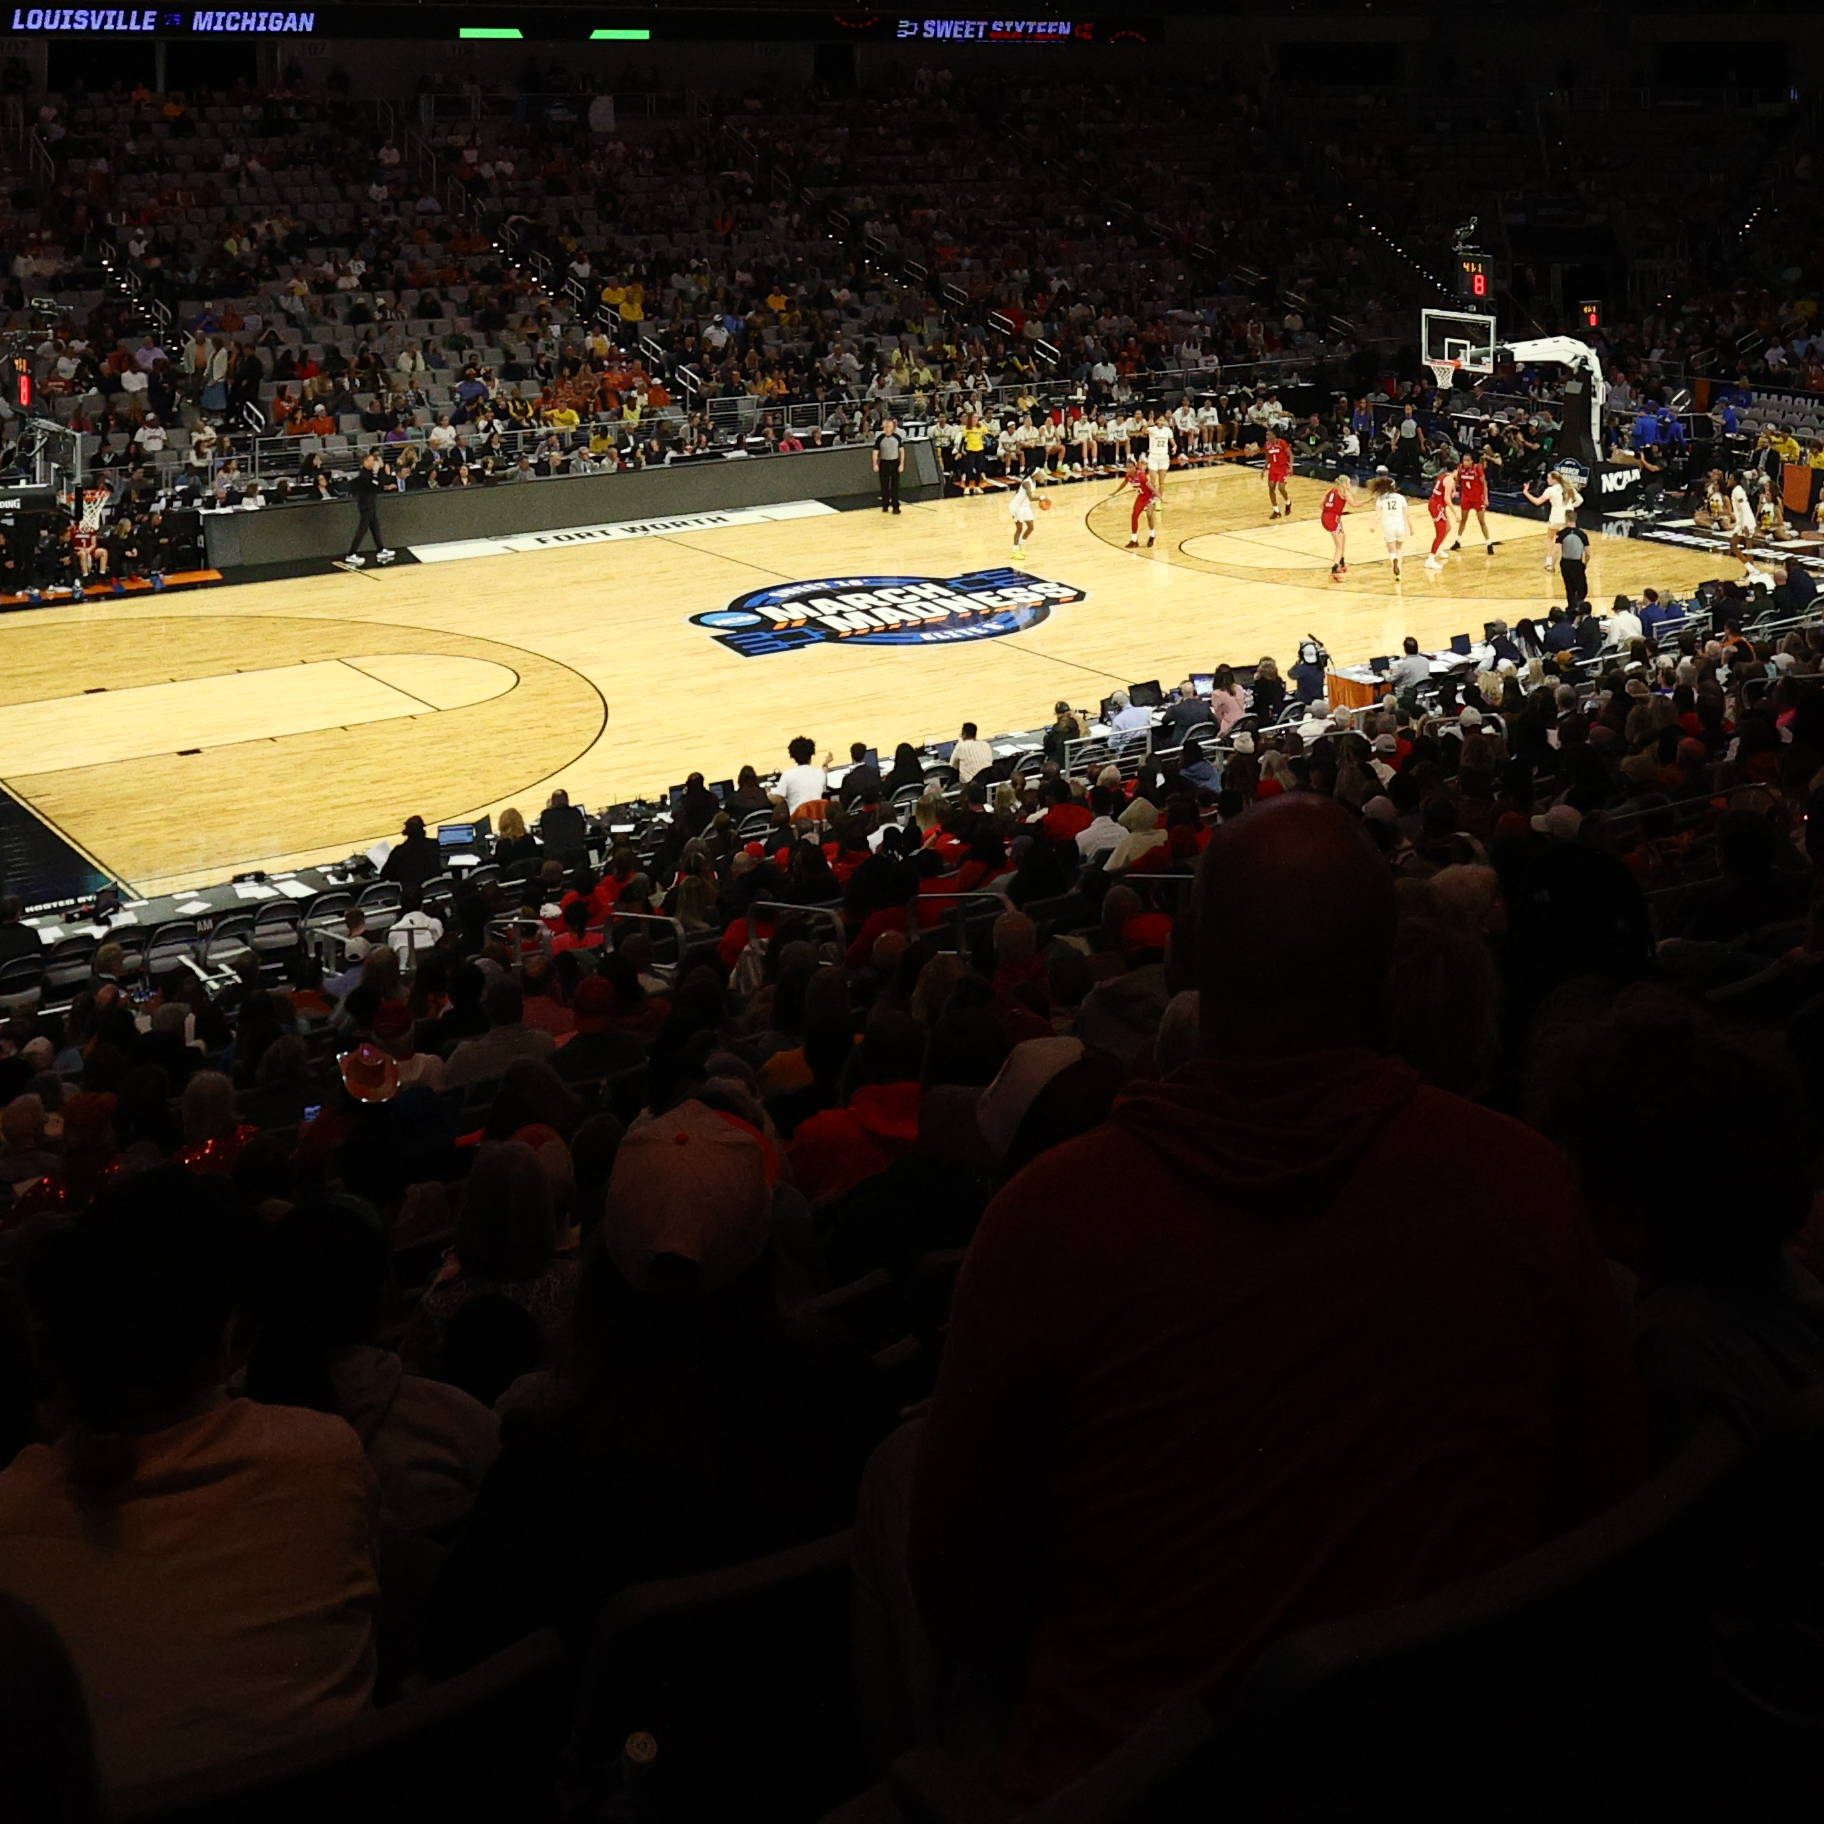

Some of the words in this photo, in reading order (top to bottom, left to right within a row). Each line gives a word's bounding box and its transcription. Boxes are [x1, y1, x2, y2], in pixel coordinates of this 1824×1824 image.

[12, 9, 157, 30] LOUISVILLE
[193, 12, 314, 31] MICHIGAN
[922, 18, 989, 41] SWEET
[989, 18, 1072, 41] SIXTEEN
[1473, 274, 1486, 296] 8
[1601, 467, 1641, 495] NCAA
[1386, 499, 1398, 511] 12
[535, 530, 612, 544] FORT
[621, 516, 728, 533] WORTH
[755, 582, 954, 622] MARCH
[817, 582, 1078, 632] MADNESS
